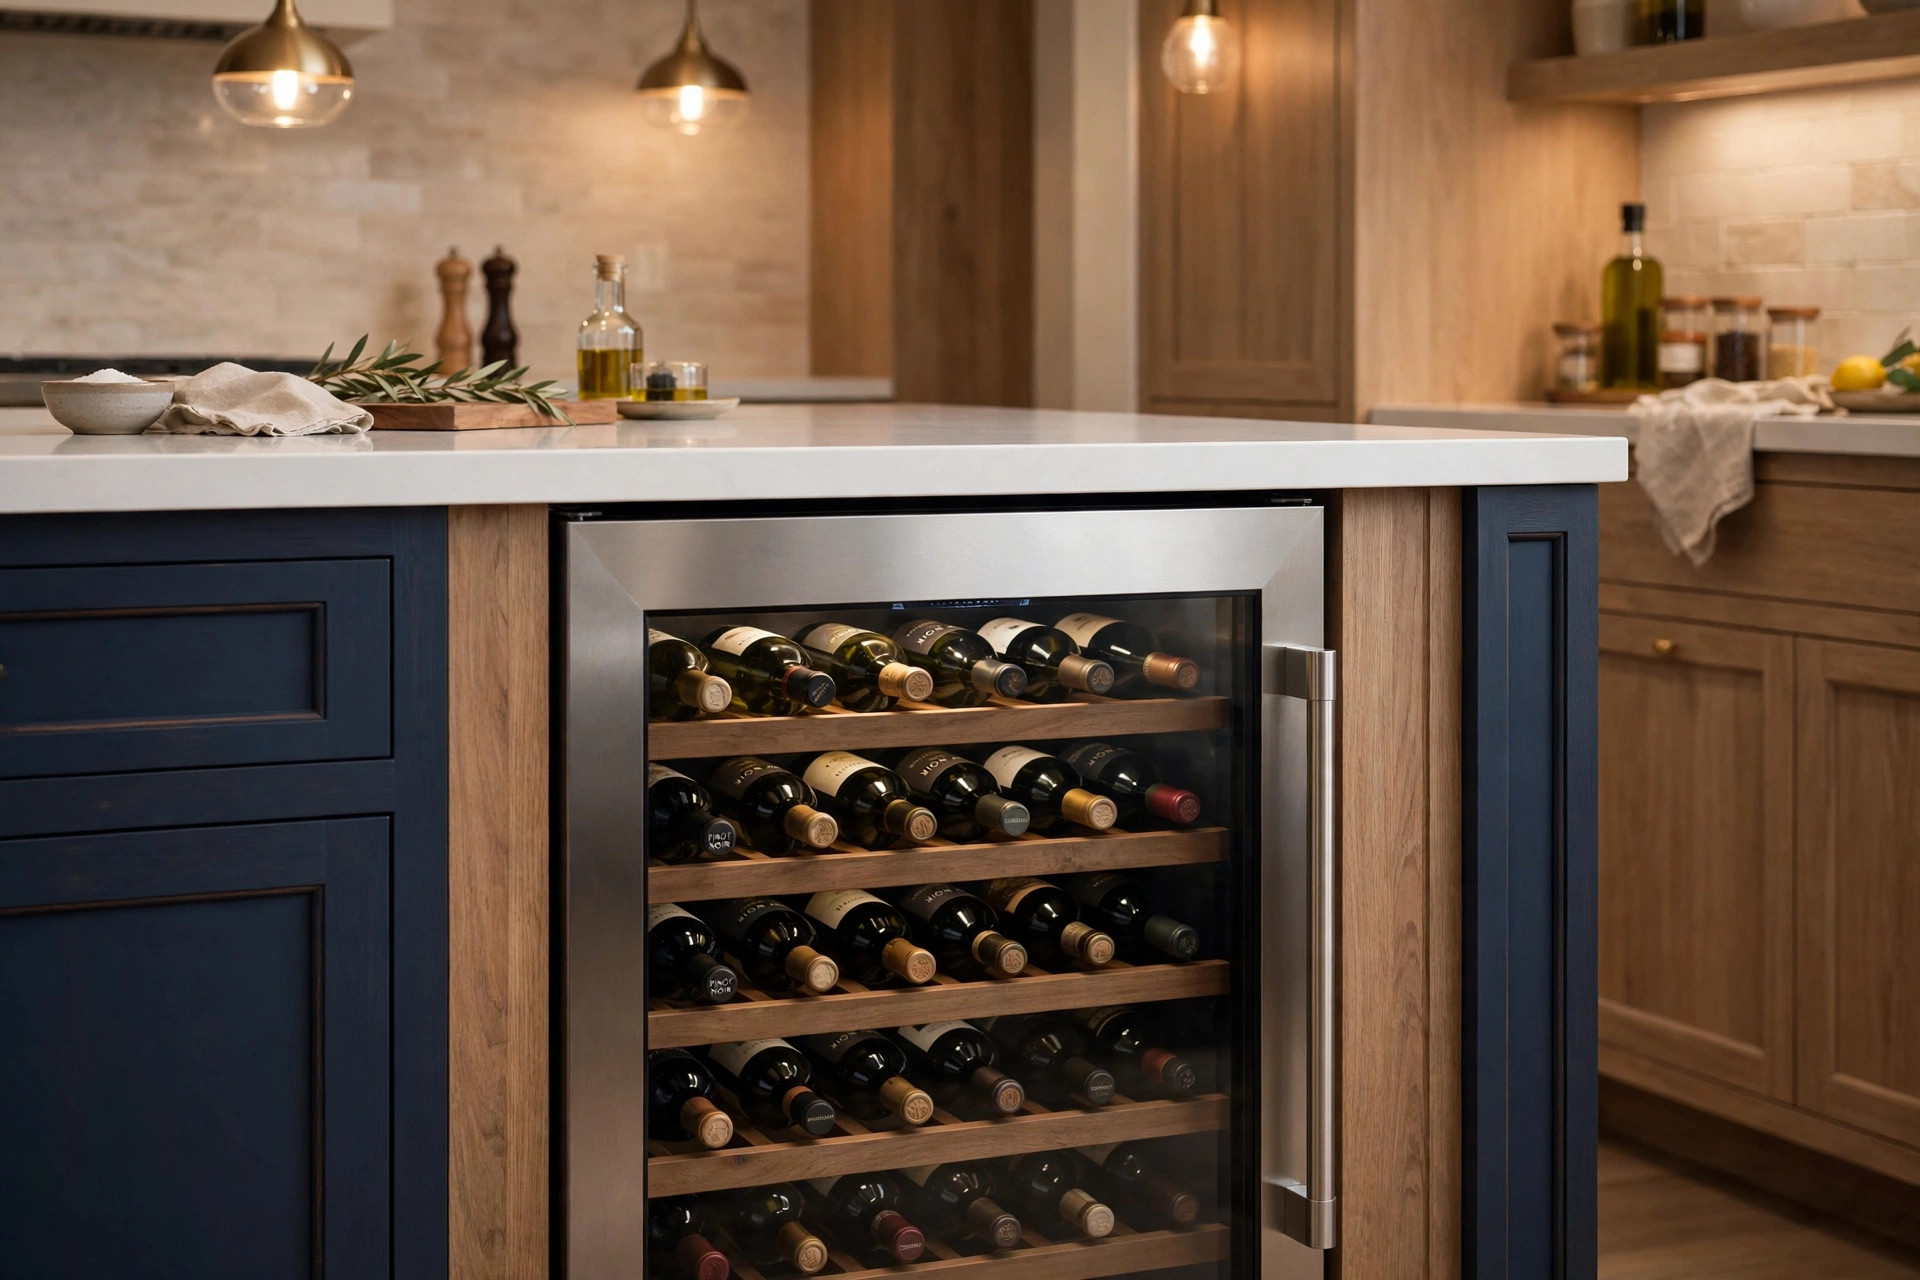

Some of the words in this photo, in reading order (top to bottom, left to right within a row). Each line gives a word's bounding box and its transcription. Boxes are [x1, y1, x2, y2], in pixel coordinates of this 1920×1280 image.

[709, 840, 731, 850] NOIR
[709, 977, 734, 987] PINOT
[711, 986, 732, 995] NOIR
